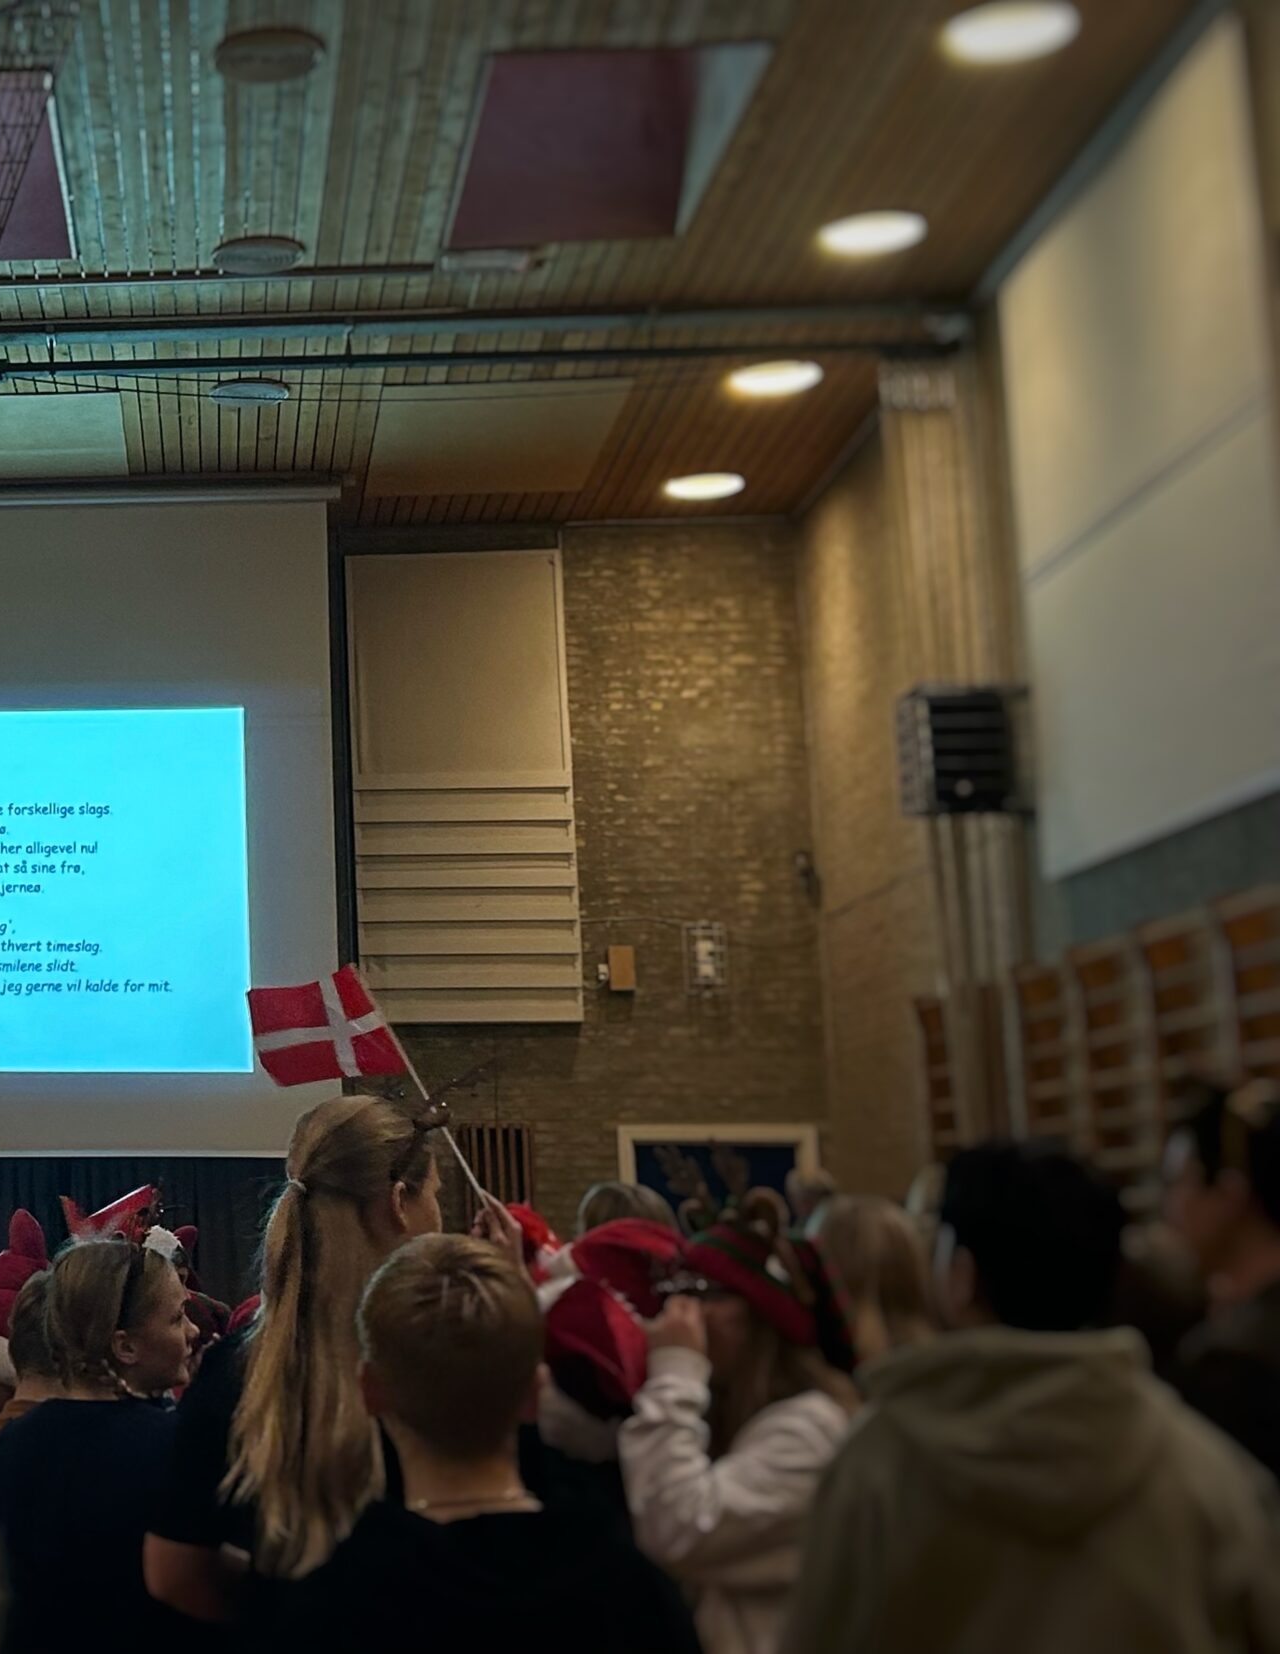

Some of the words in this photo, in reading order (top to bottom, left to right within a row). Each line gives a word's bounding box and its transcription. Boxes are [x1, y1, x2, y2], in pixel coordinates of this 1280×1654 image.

[7, 802, 75, 819] forskellige
[78, 801, 113, 818] slags.
[0, 842, 23, 855] her
[25, 841, 77, 858] alligevel
[80, 841, 98, 855] nu!
[13, 859, 28, 874] så
[30, 863, 57, 874] sine
[60, 860, 86, 876] frø,
[46, 939, 103, 955] timeslag.
[0, 980, 22, 996] jeg
[25, 982, 62, 996] gerne
[66, 979, 82, 992] vil
[84, 979, 119, 992] kalde
[123, 979, 145, 993] for
[148, 979, 173, 993] mit.
